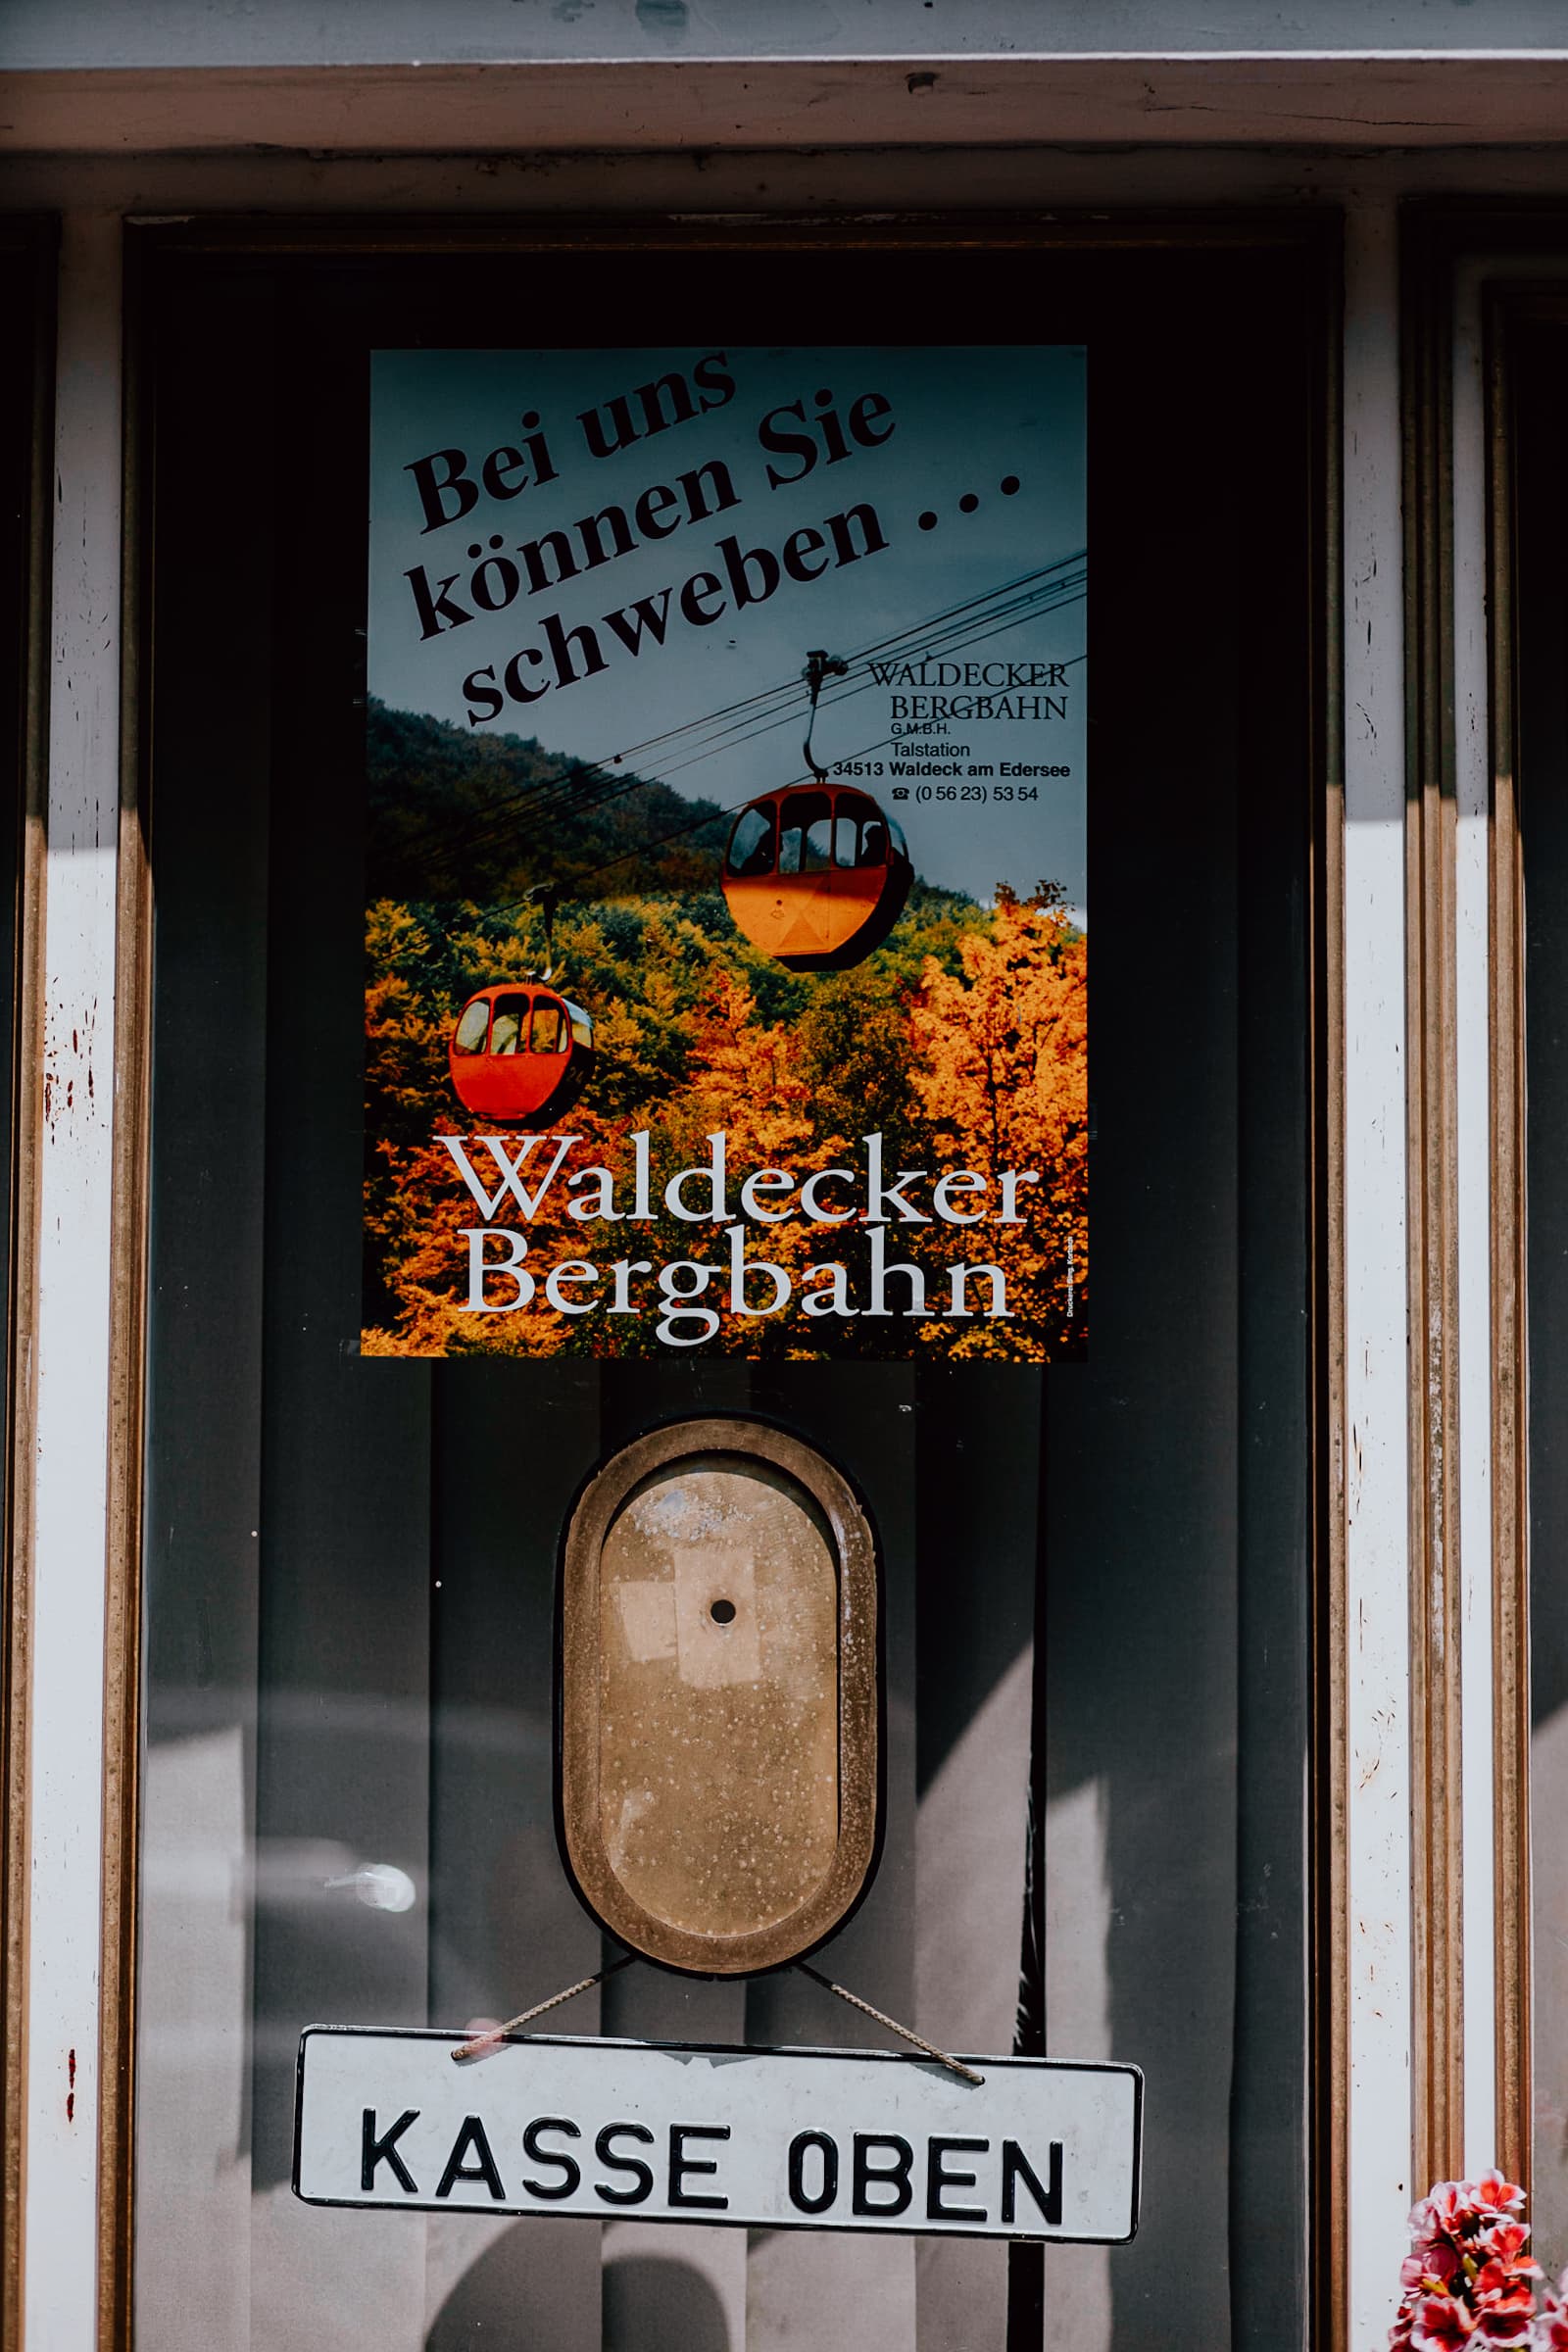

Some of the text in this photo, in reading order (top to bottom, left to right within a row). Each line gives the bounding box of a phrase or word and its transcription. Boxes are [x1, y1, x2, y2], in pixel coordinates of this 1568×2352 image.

[403, 350, 738, 535] Bei uns
[403, 388, 897, 641] können Sie
[462, 503, 890, 727] schweben
[868, 662, 1070, 687] WALDECKER
[890, 695, 1068, 720] BERGBAHN
[833, 761, 1070, 777] 34513 Waldeck am Edersee
[890, 723, 951, 735] G.M.B.H.
[891, 742, 970, 757] Talstation
[432, 1129, 1040, 1225] Waldecker
[457, 1223, 1015, 1347] Bergbahn
[360, 2107, 1064, 2227] KASSE OBEN
